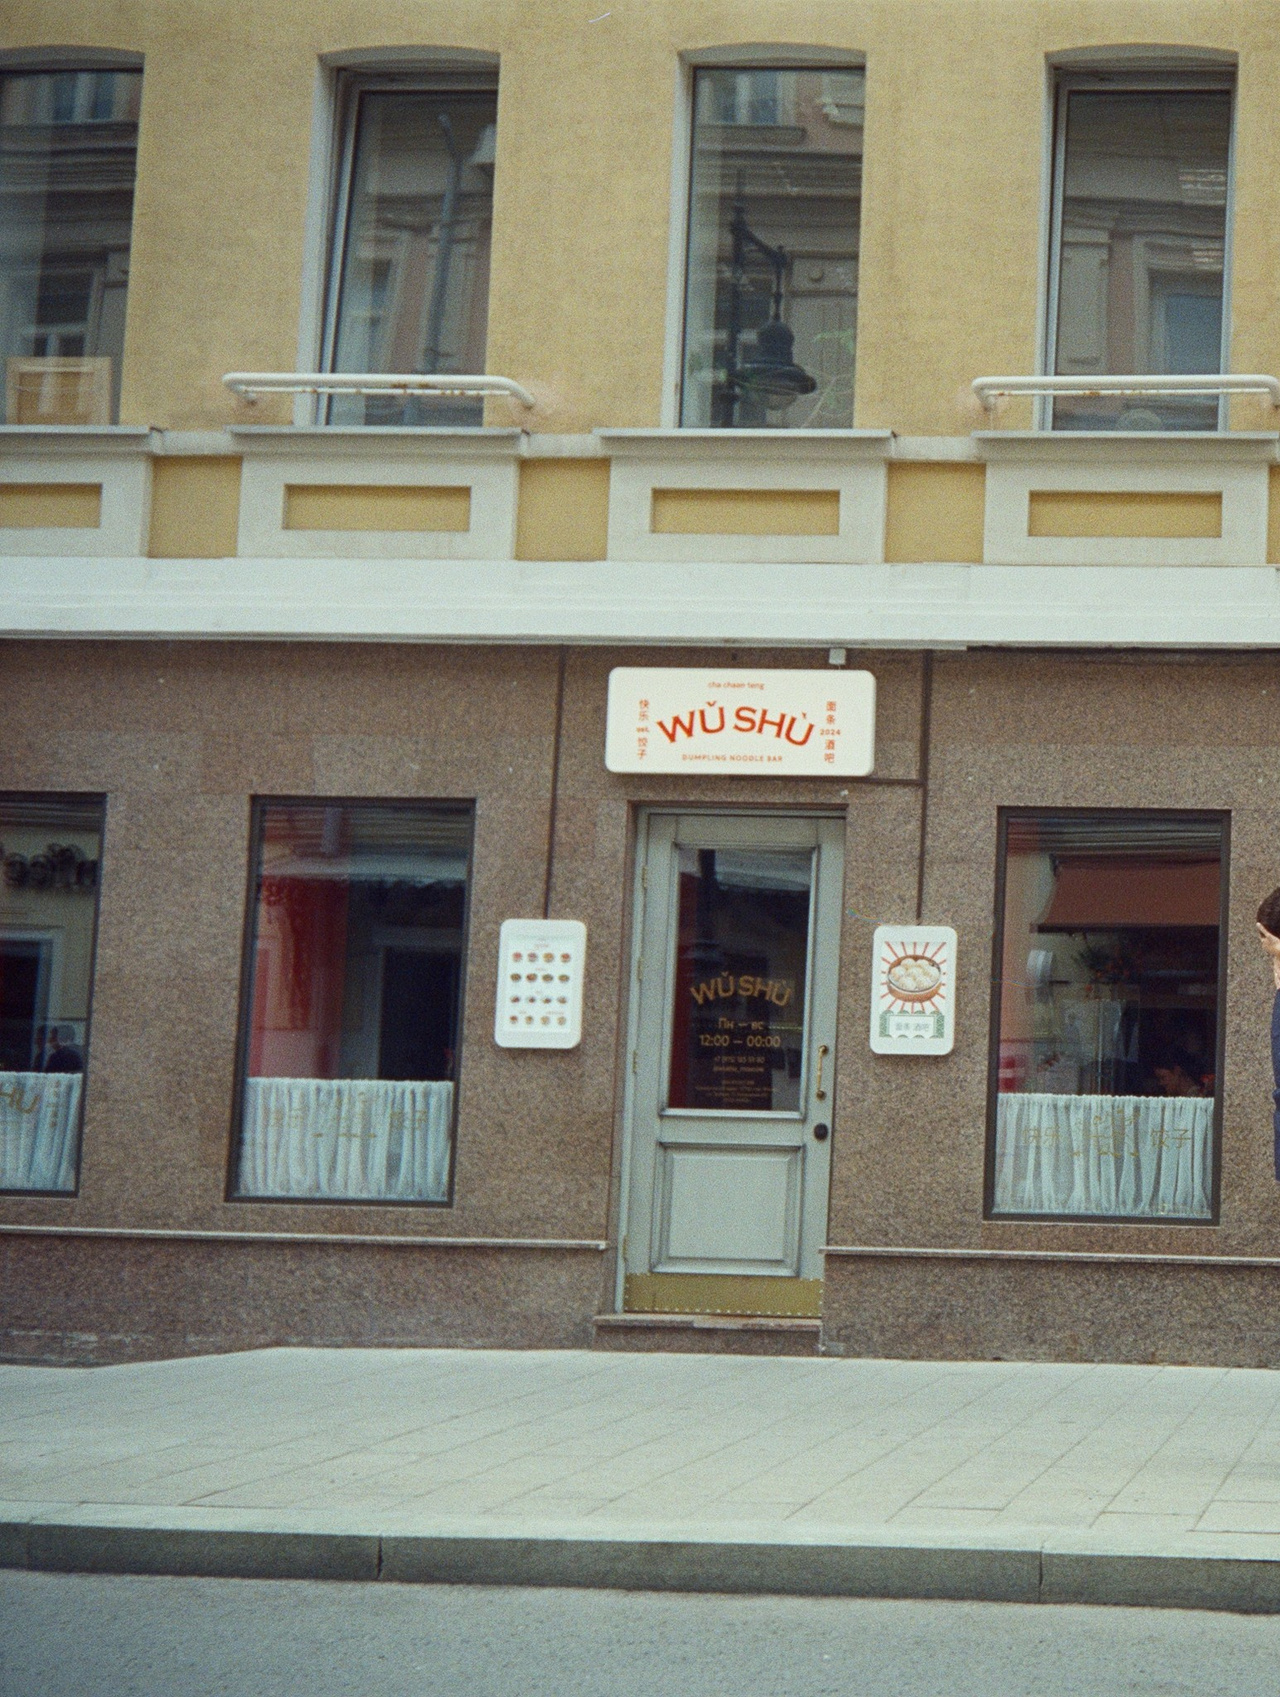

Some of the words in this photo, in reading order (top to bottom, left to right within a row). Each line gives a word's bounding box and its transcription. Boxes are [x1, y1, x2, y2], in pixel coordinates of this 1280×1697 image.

[708, 681, 721, 689] cha
[723, 681, 746, 689] chaan
[748, 682, 765, 690] teng
[819, 728, 842, 736] 2024
[682, 753, 727, 761] DUMPLING
[729, 754, 764, 762] NOODLE
[767, 755, 783, 763] BAR
[700, 1034, 730, 1047] 12:00
[746, 1035, 781, 1048] 00:00
